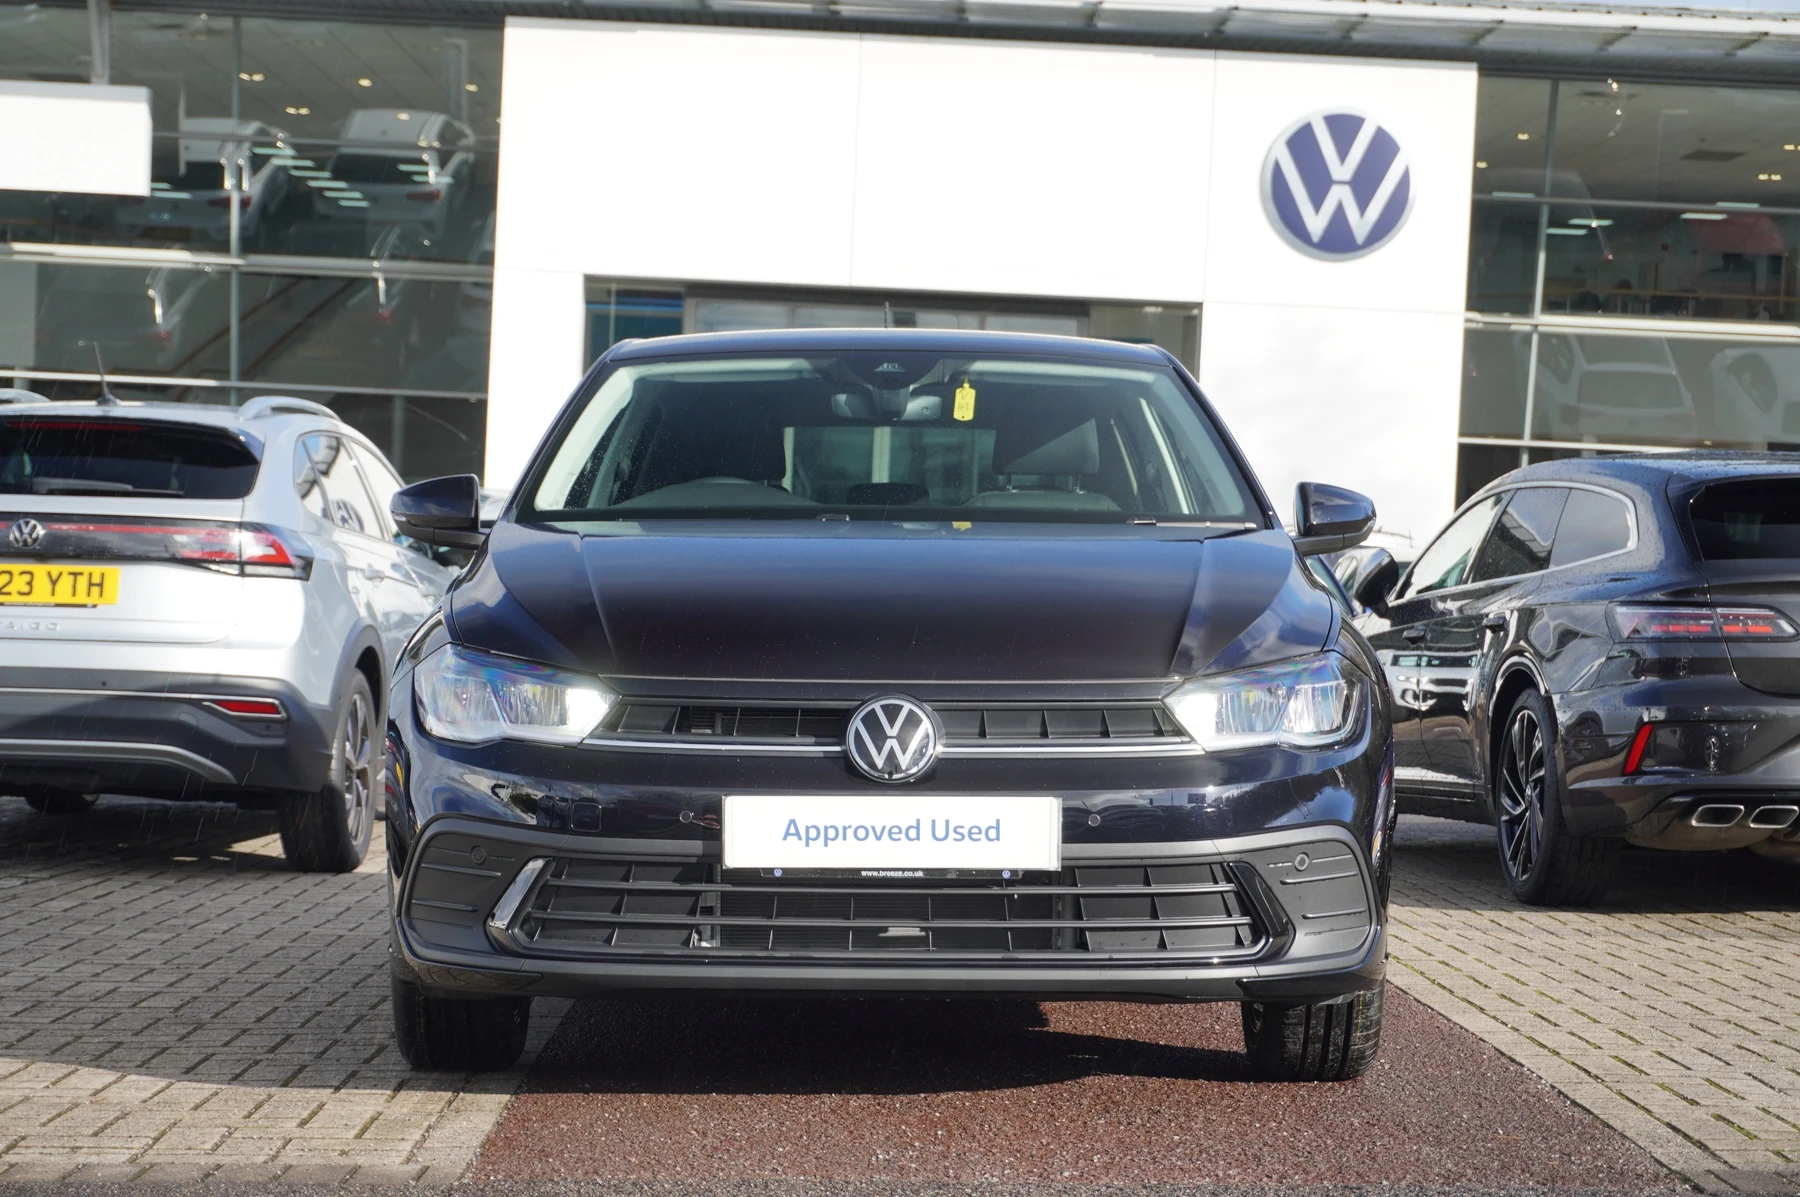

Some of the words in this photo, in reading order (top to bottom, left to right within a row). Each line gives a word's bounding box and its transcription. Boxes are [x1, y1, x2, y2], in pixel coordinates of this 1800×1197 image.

[1267, 110, 1411, 254] VW
[11, 518, 43, 548] VW
[0, 570, 34, 596] 23
[47, 571, 105, 598] YTH
[852, 699, 932, 775] VW
[781, 818, 921, 848] Approved
[931, 818, 1001, 842] Used
[860, 869, 924, 878] www.breeze.co.uk
